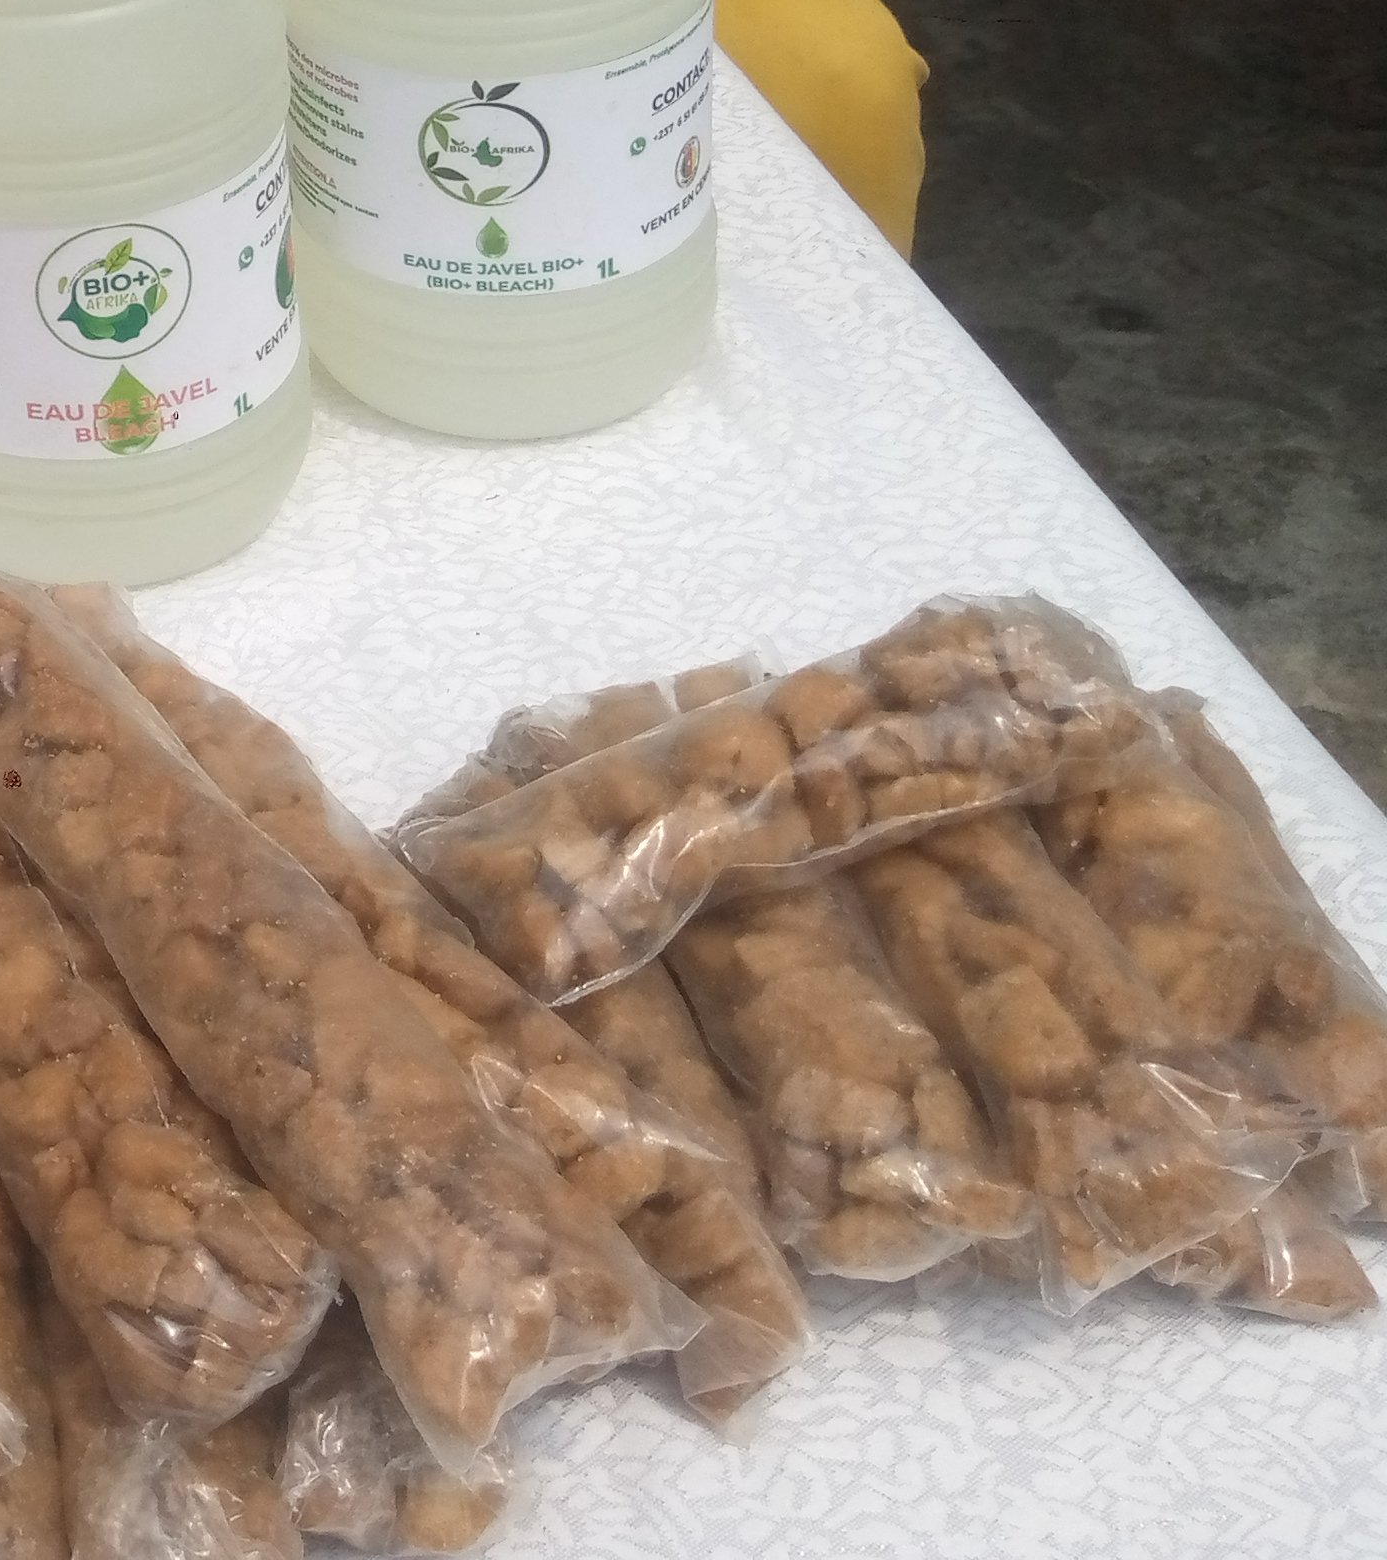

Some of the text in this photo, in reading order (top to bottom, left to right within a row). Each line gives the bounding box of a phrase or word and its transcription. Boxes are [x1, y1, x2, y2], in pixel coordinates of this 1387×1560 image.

[330, 117, 365, 140] stains
[653, 122, 674, 142] +237
[640, 191, 696, 236] VENTE EN
[402, 253, 621, 279] EAU DE JAVEL BIO+ 1L
[83, 270, 150, 297] BIO+
[426, 274, 555, 293] (BIO+ BLEACH)
[85, 292, 139, 311] AFRIKA
[255, 316, 289, 363] VENTE
[25, 376, 255, 422] EAU DE JAVEL 1L
[74, 414, 177, 444] BLEACH
